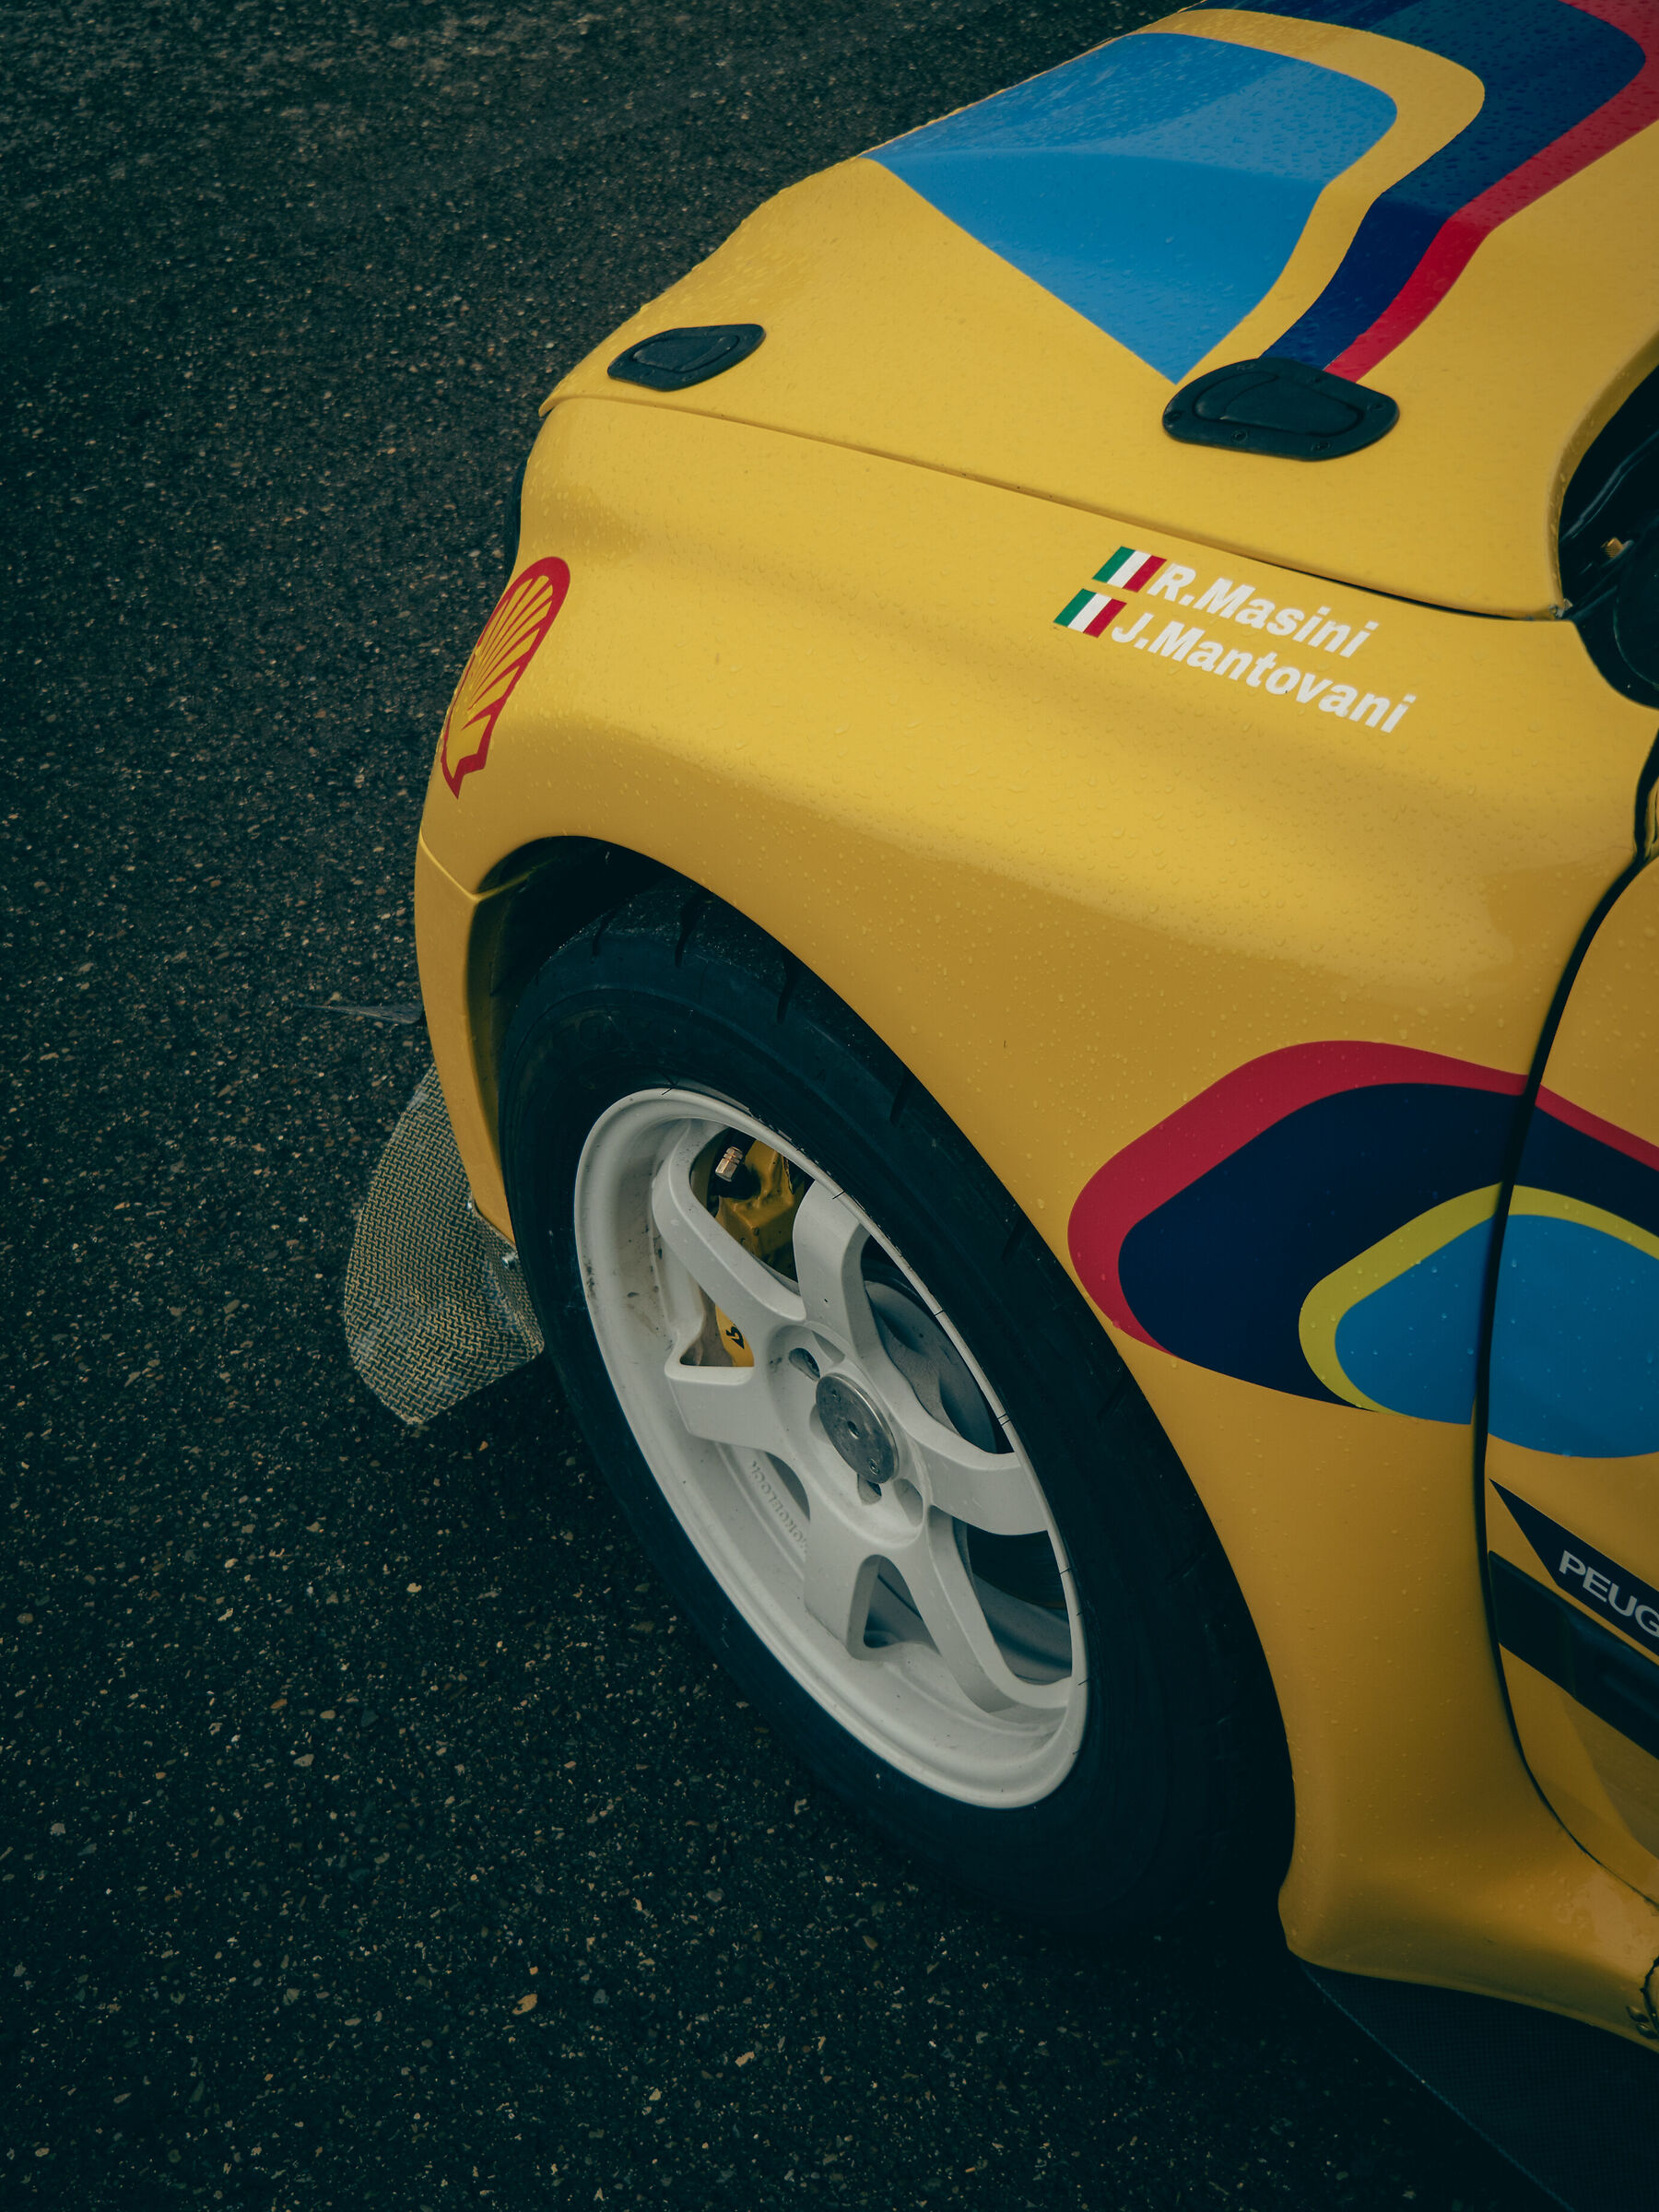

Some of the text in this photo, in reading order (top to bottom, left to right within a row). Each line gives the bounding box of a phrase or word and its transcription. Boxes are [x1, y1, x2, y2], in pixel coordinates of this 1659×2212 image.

[1147, 562, 1380, 658] R.Masini
[1111, 612, 1417, 734] J.Mantovani
[1559, 1549, 1659, 1639] PEUG
